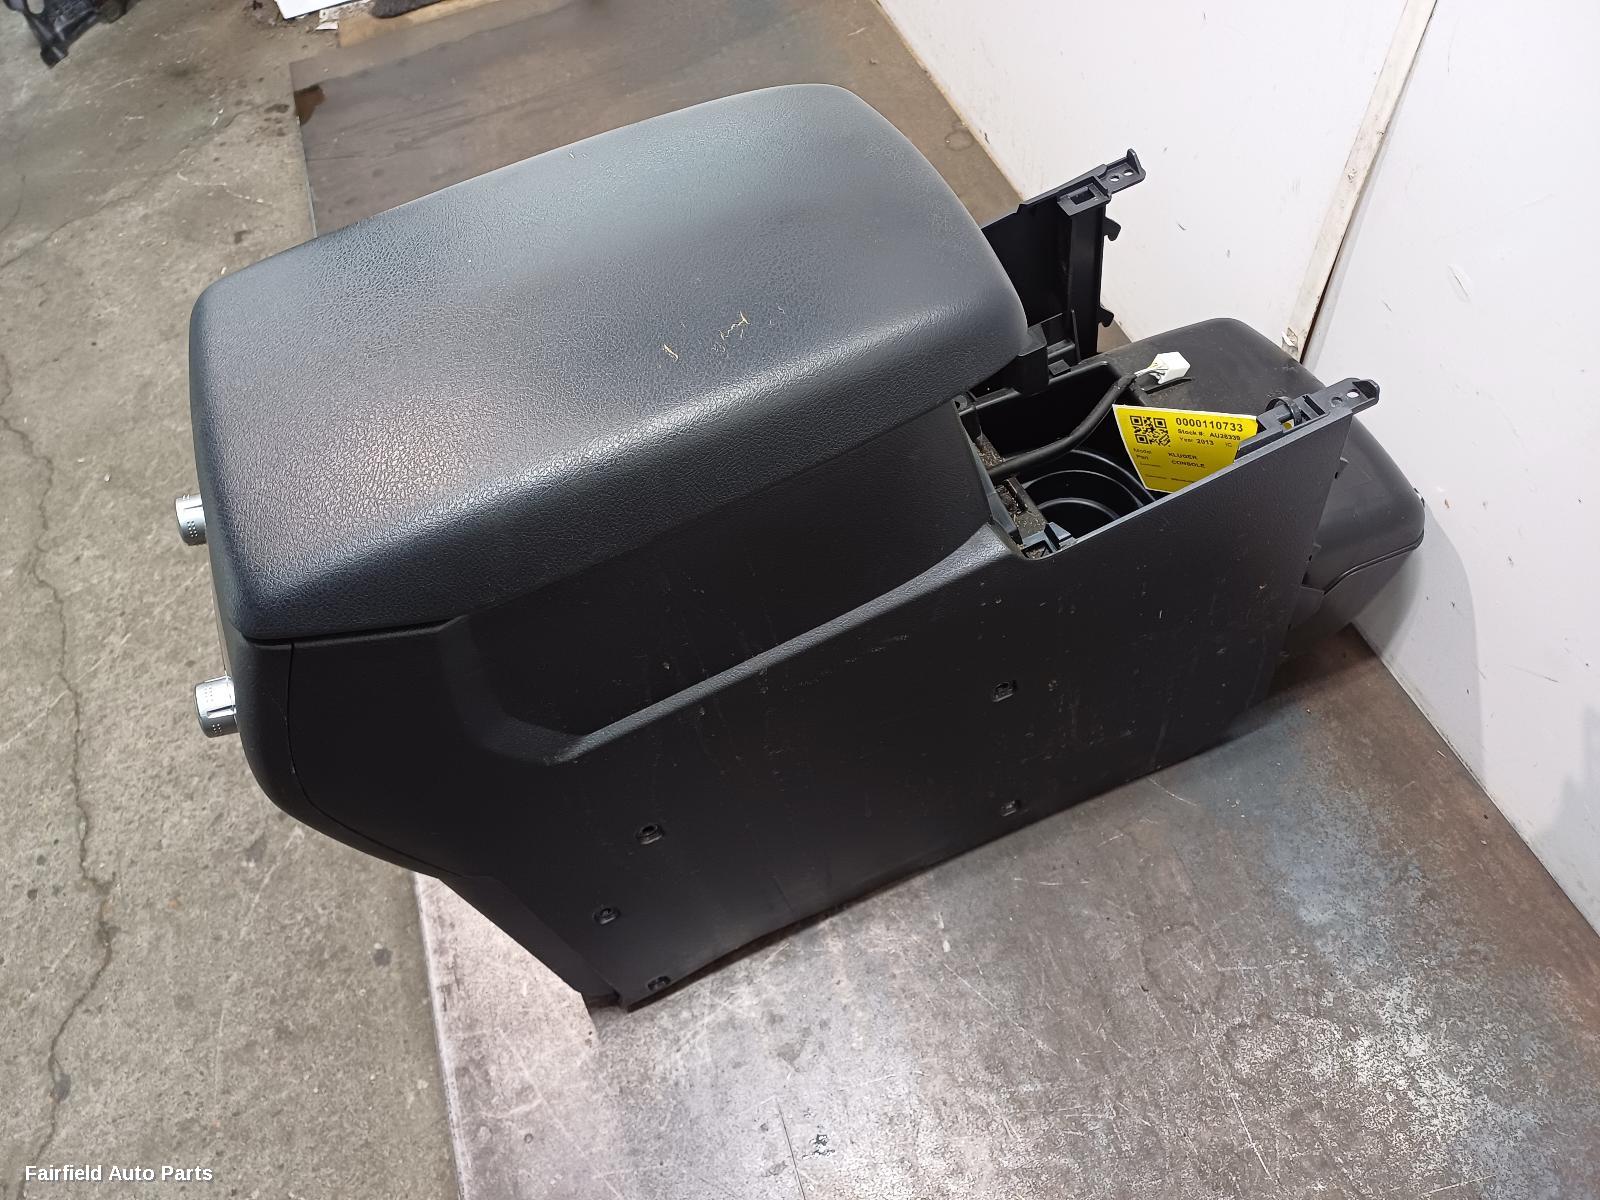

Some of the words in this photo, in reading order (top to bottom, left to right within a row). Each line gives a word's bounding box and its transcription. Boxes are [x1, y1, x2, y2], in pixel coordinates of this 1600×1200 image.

[1176, 417, 1243, 432] 0000110733
[1168, 452, 1197, 460] KLUGER
[1171, 460, 1206, 468] CONSOLE
